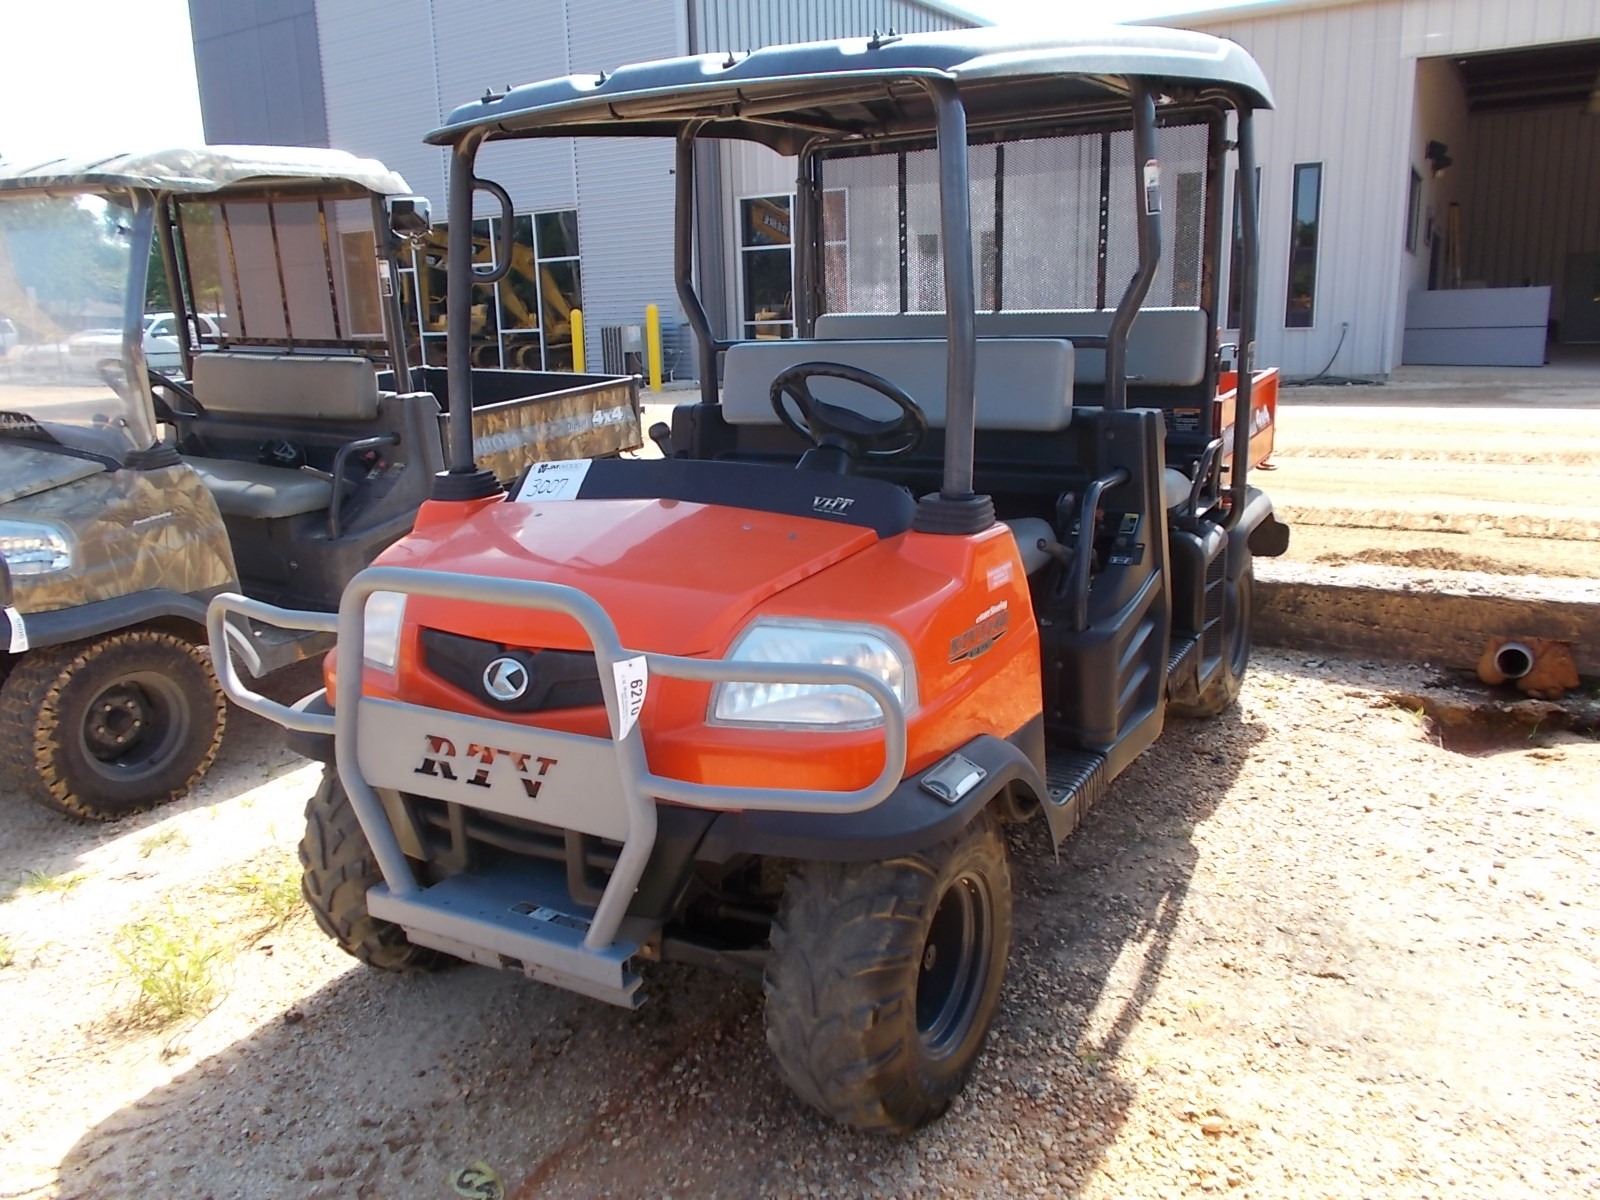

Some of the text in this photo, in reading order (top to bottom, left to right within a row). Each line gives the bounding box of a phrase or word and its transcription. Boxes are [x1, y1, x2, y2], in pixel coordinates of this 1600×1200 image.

[592, 406, 624, 425] 4x4
[526, 478, 569, 497] 3007
[413, 734, 558, 799] RTV
